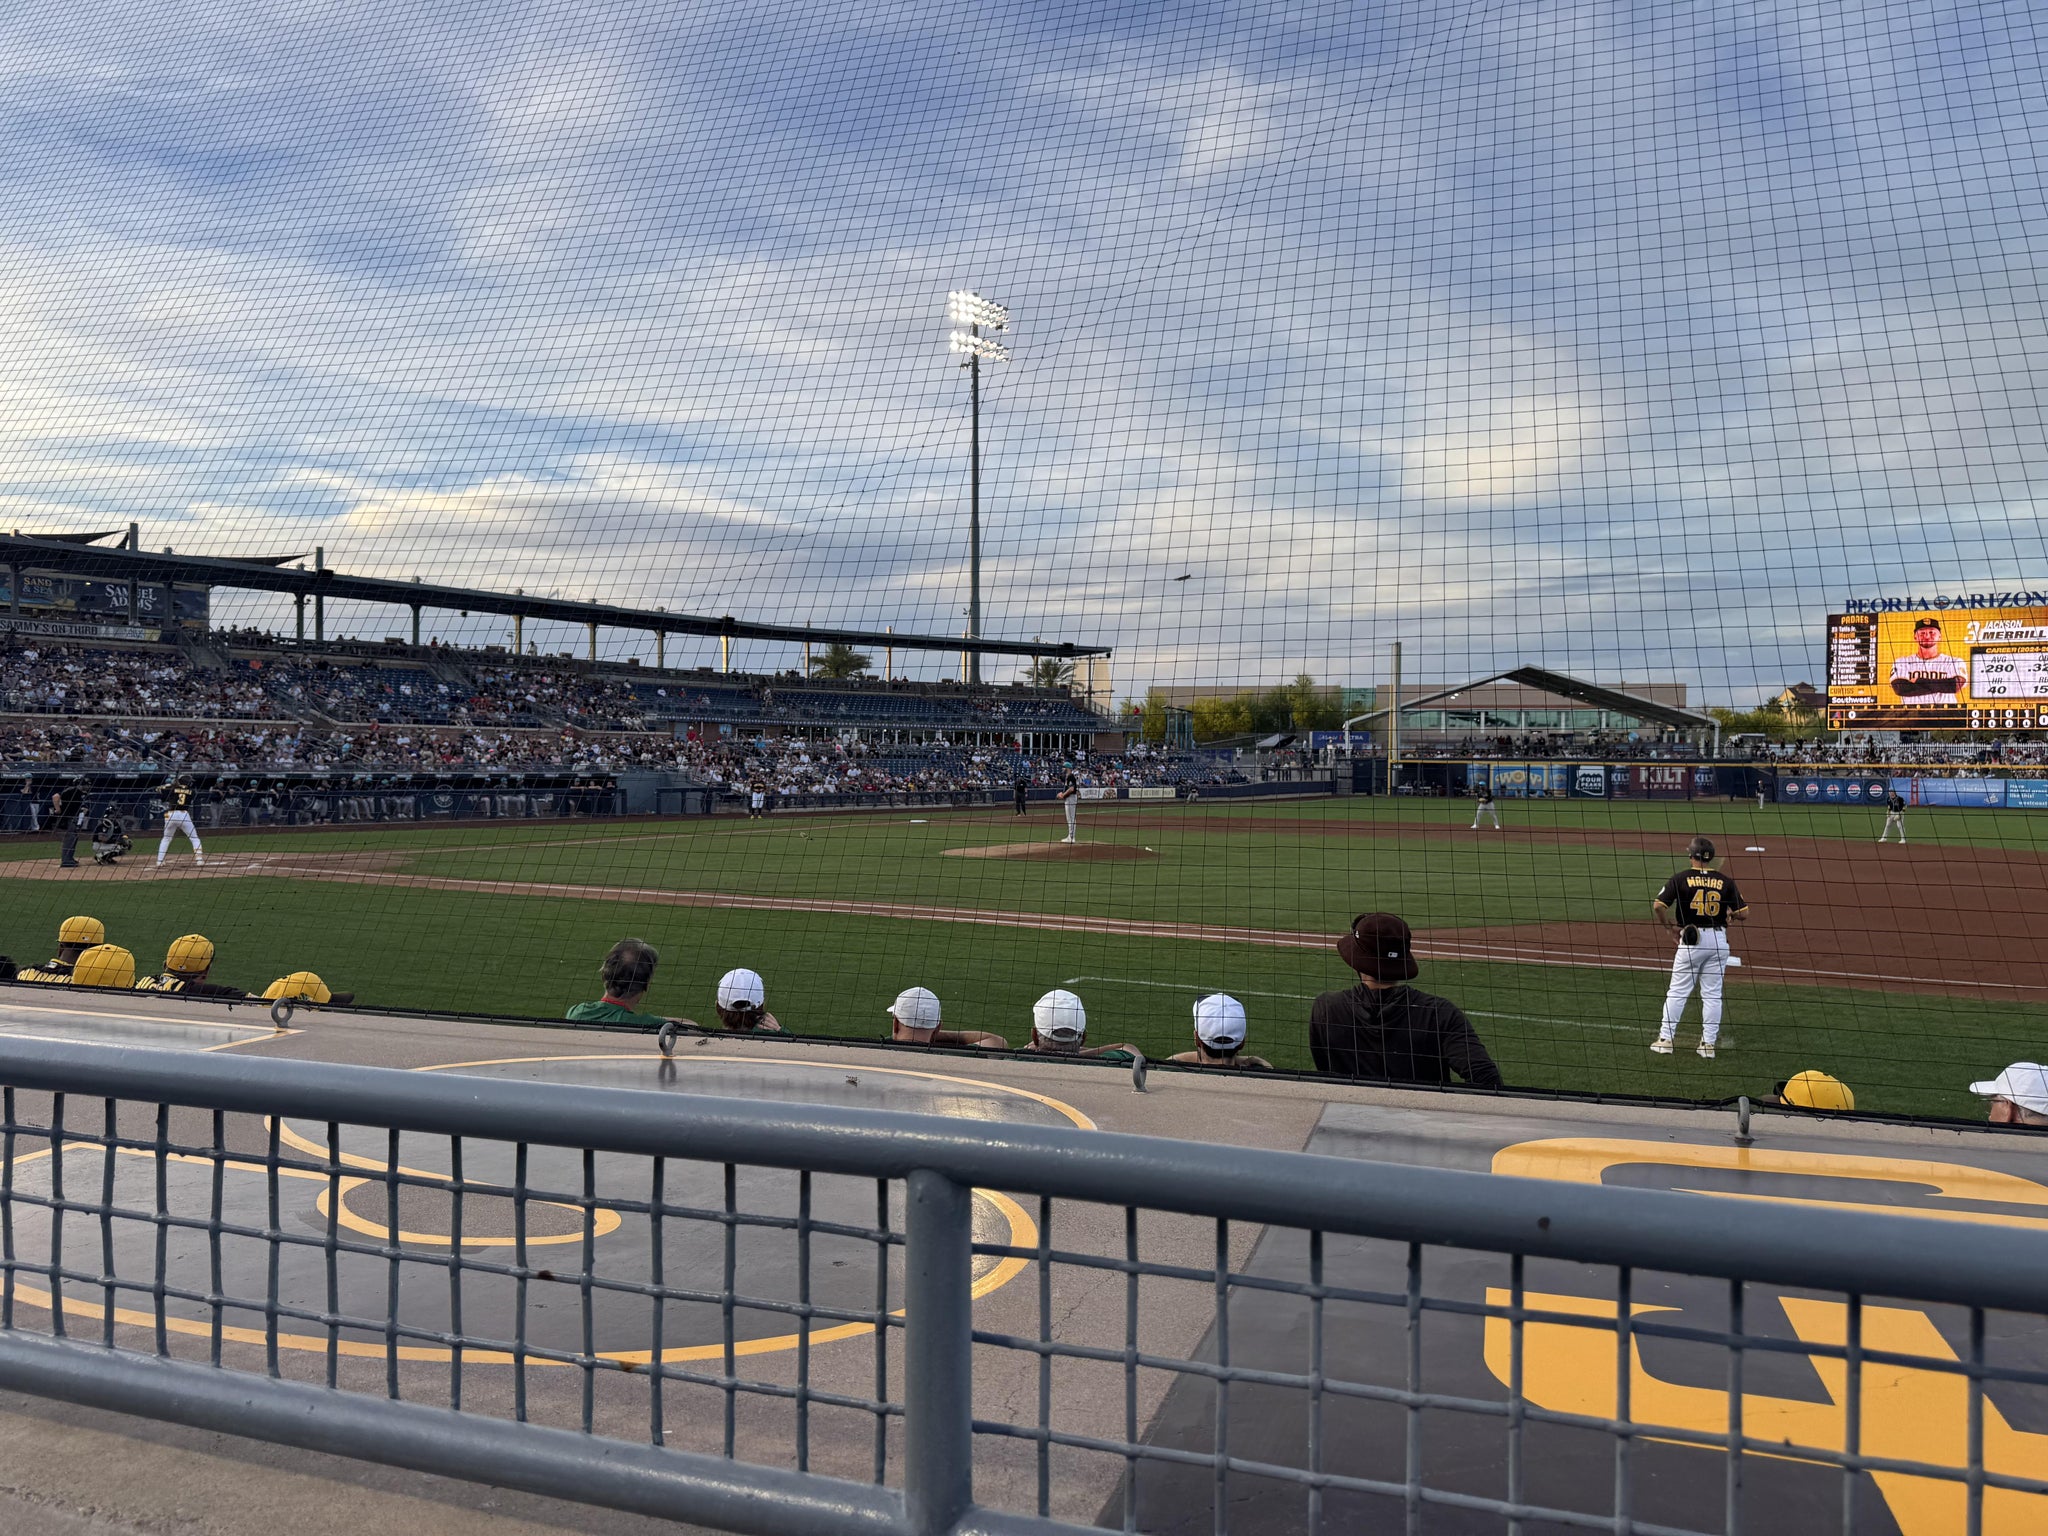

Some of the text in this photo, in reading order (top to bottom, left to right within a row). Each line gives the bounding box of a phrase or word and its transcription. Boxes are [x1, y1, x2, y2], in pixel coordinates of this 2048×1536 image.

[24, 577, 53, 587] SAND
[110, 597, 152, 611] ADMS
[1845, 591, 2048, 613] PEORIA ARIZON
[1841, 615, 1869, 625] PADRES
[1985, 620, 2023, 630] JACKSON
[0, 621, 98, 635] SAMMY'S ON THIRD
[1964, 621, 1981, 644] 3
[1983, 630, 2046, 640] MERRILL
[1981, 664, 2014, 673] .280
[1830, 687, 1855, 695] CURTISS
[1987, 686, 2007, 695] 40
[1831, 696, 1872, 704] Southwest
[1848, 711, 1857, 720] 0
[1971, 709, 1980, 718] 0
[2005, 709, 2014, 718] 0
[2038, 715, 2048, 726] 0
[1640, 766, 1687, 784] KILT
[1686, 876, 1724, 891] MACIAS
[1690, 889, 1721, 917] 46
